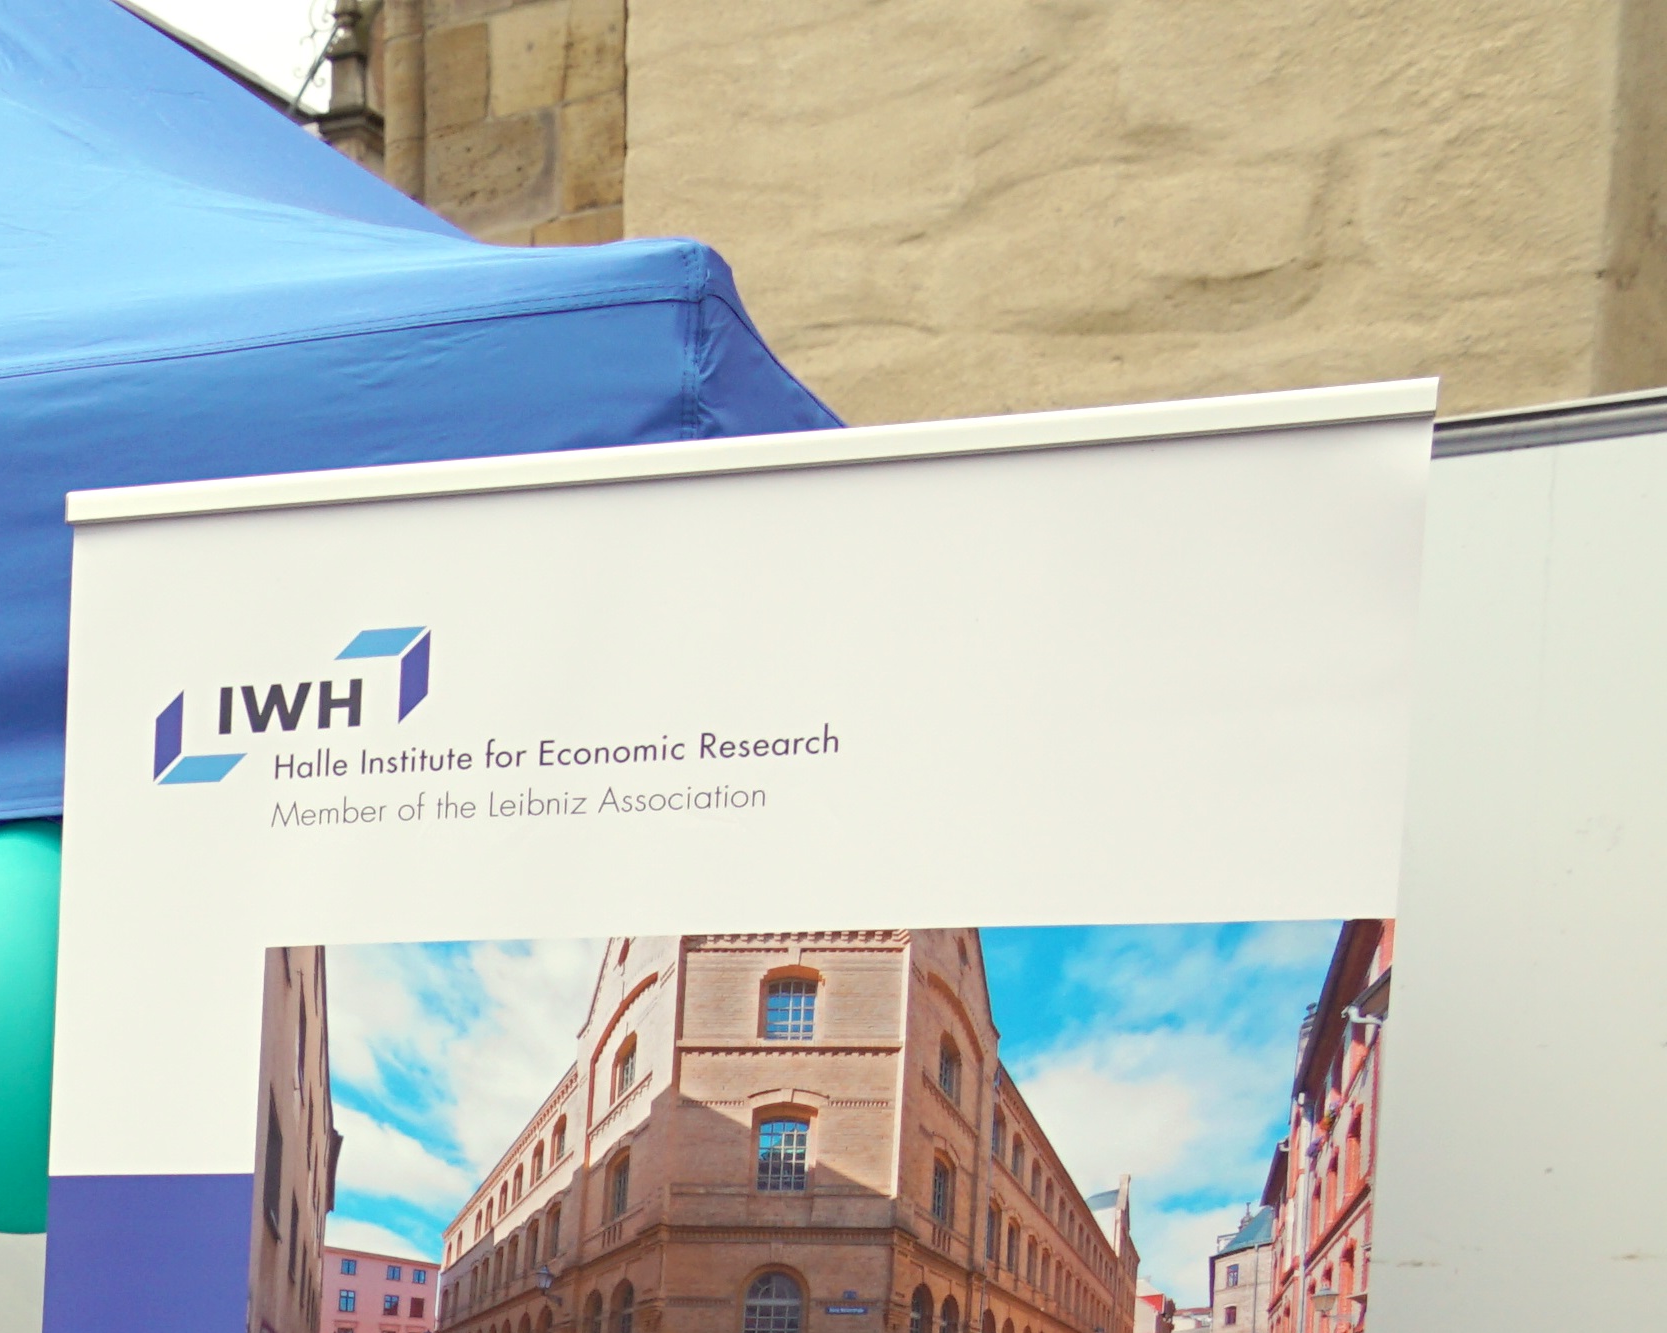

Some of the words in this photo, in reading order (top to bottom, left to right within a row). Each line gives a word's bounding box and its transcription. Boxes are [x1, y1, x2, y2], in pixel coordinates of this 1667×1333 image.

[219, 678, 362, 735] IWH
[275, 748, 347, 779] Halle
[362, 747, 472, 774] Institute
[486, 739, 527, 768] for
[539, 735, 685, 766] Economic
[700, 723, 838, 759] Research
[271, 796, 387, 827] Member
[398, 792, 425, 821] of
[437, 791, 476, 819] the
[490, 787, 587, 817] Leibniz
[598, 785, 765, 813] Association
